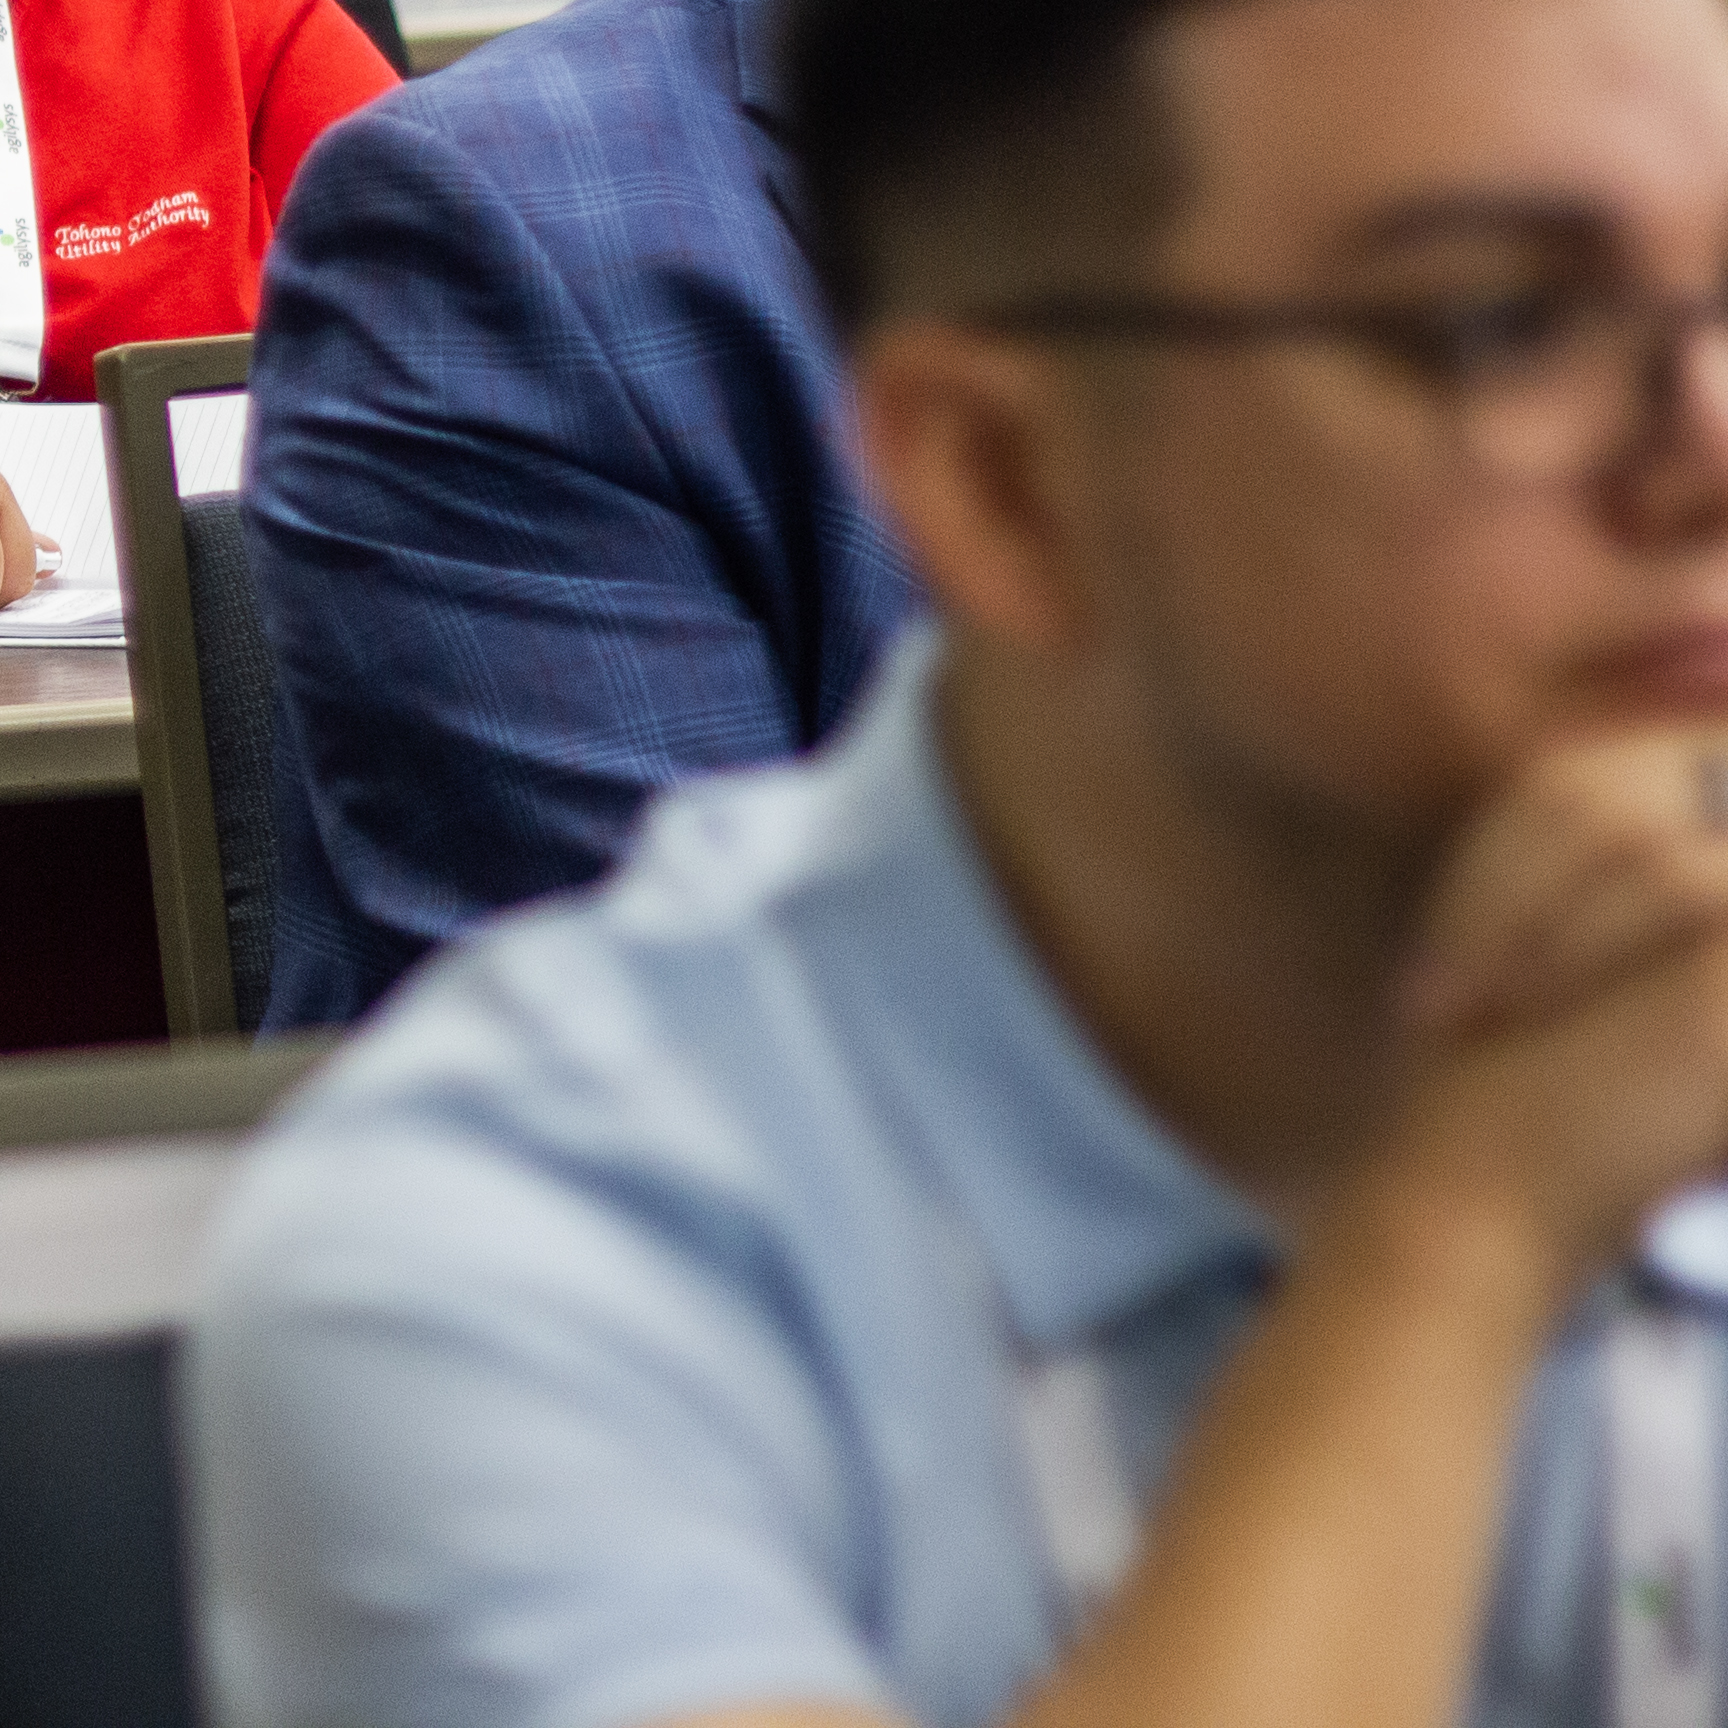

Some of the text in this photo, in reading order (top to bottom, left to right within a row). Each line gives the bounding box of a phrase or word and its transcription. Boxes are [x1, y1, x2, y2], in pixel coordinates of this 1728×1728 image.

[3, 103, 22, 155] agilysys
[14, 217, 33, 268] agilysys
[55, 205, 210, 261] Utility Authority
[55, 223, 122, 245] Tohono
